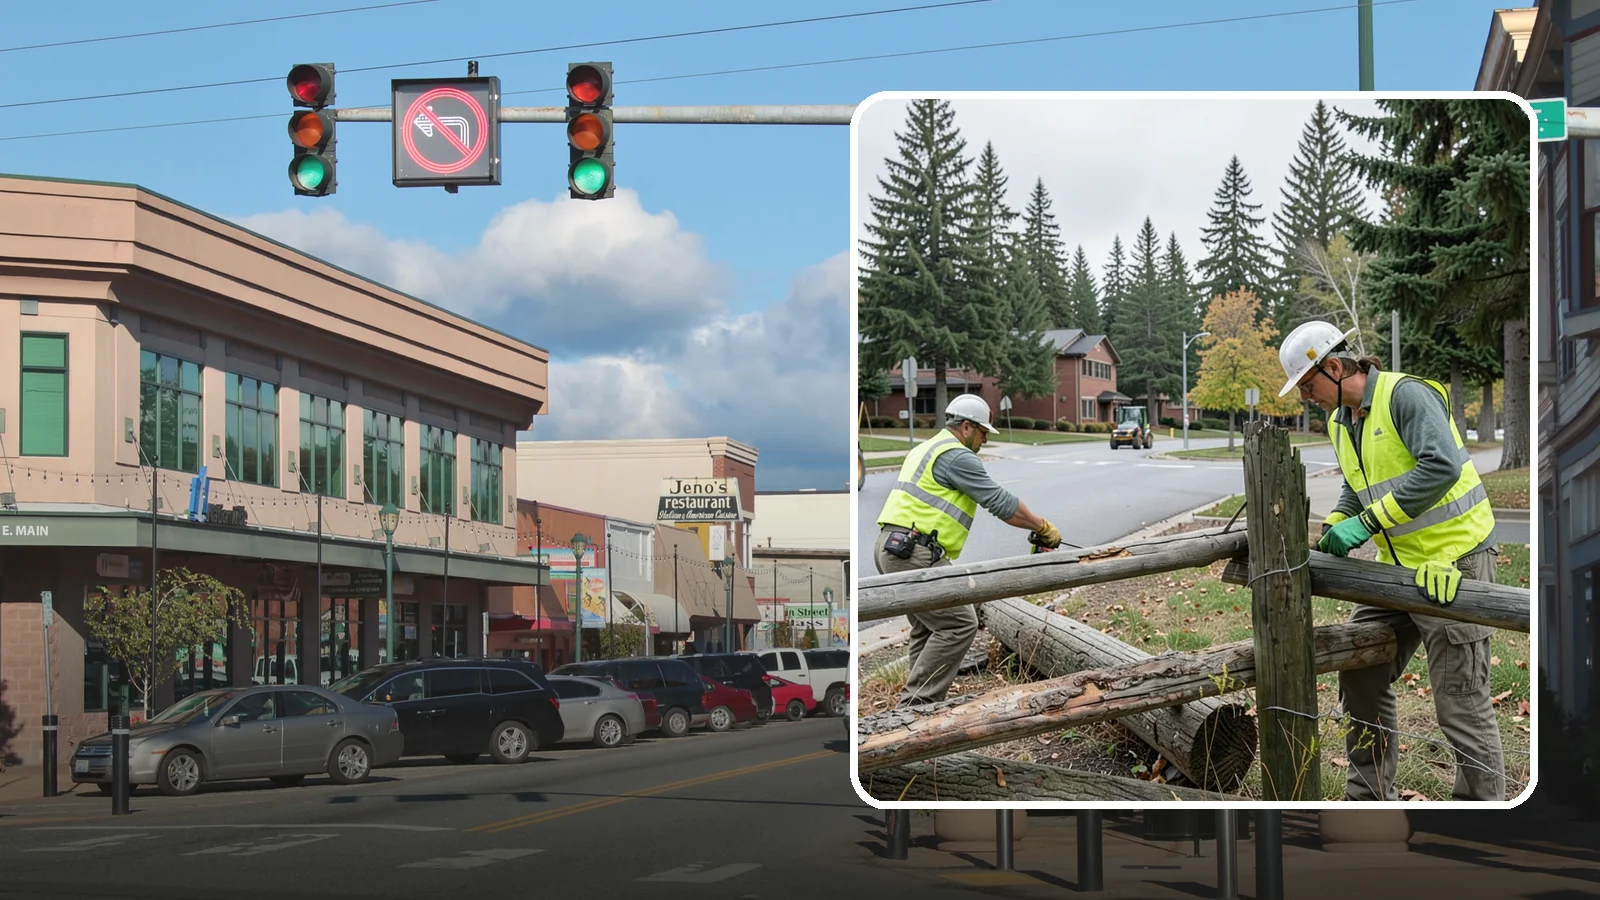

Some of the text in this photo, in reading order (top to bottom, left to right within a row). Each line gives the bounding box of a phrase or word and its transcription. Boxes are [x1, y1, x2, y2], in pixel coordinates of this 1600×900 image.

[669, 480, 728, 495] Jeno's
[665, 496, 731, 509] restaurant
[658, 509, 681, 520] Italian
[686, 509, 714, 519] American
[715, 509, 737, 519] Cuisine
[2, 525, 49, 536] E. MAIN
[797, 607, 829, 617] Street
[791, 619, 824, 627] lass
